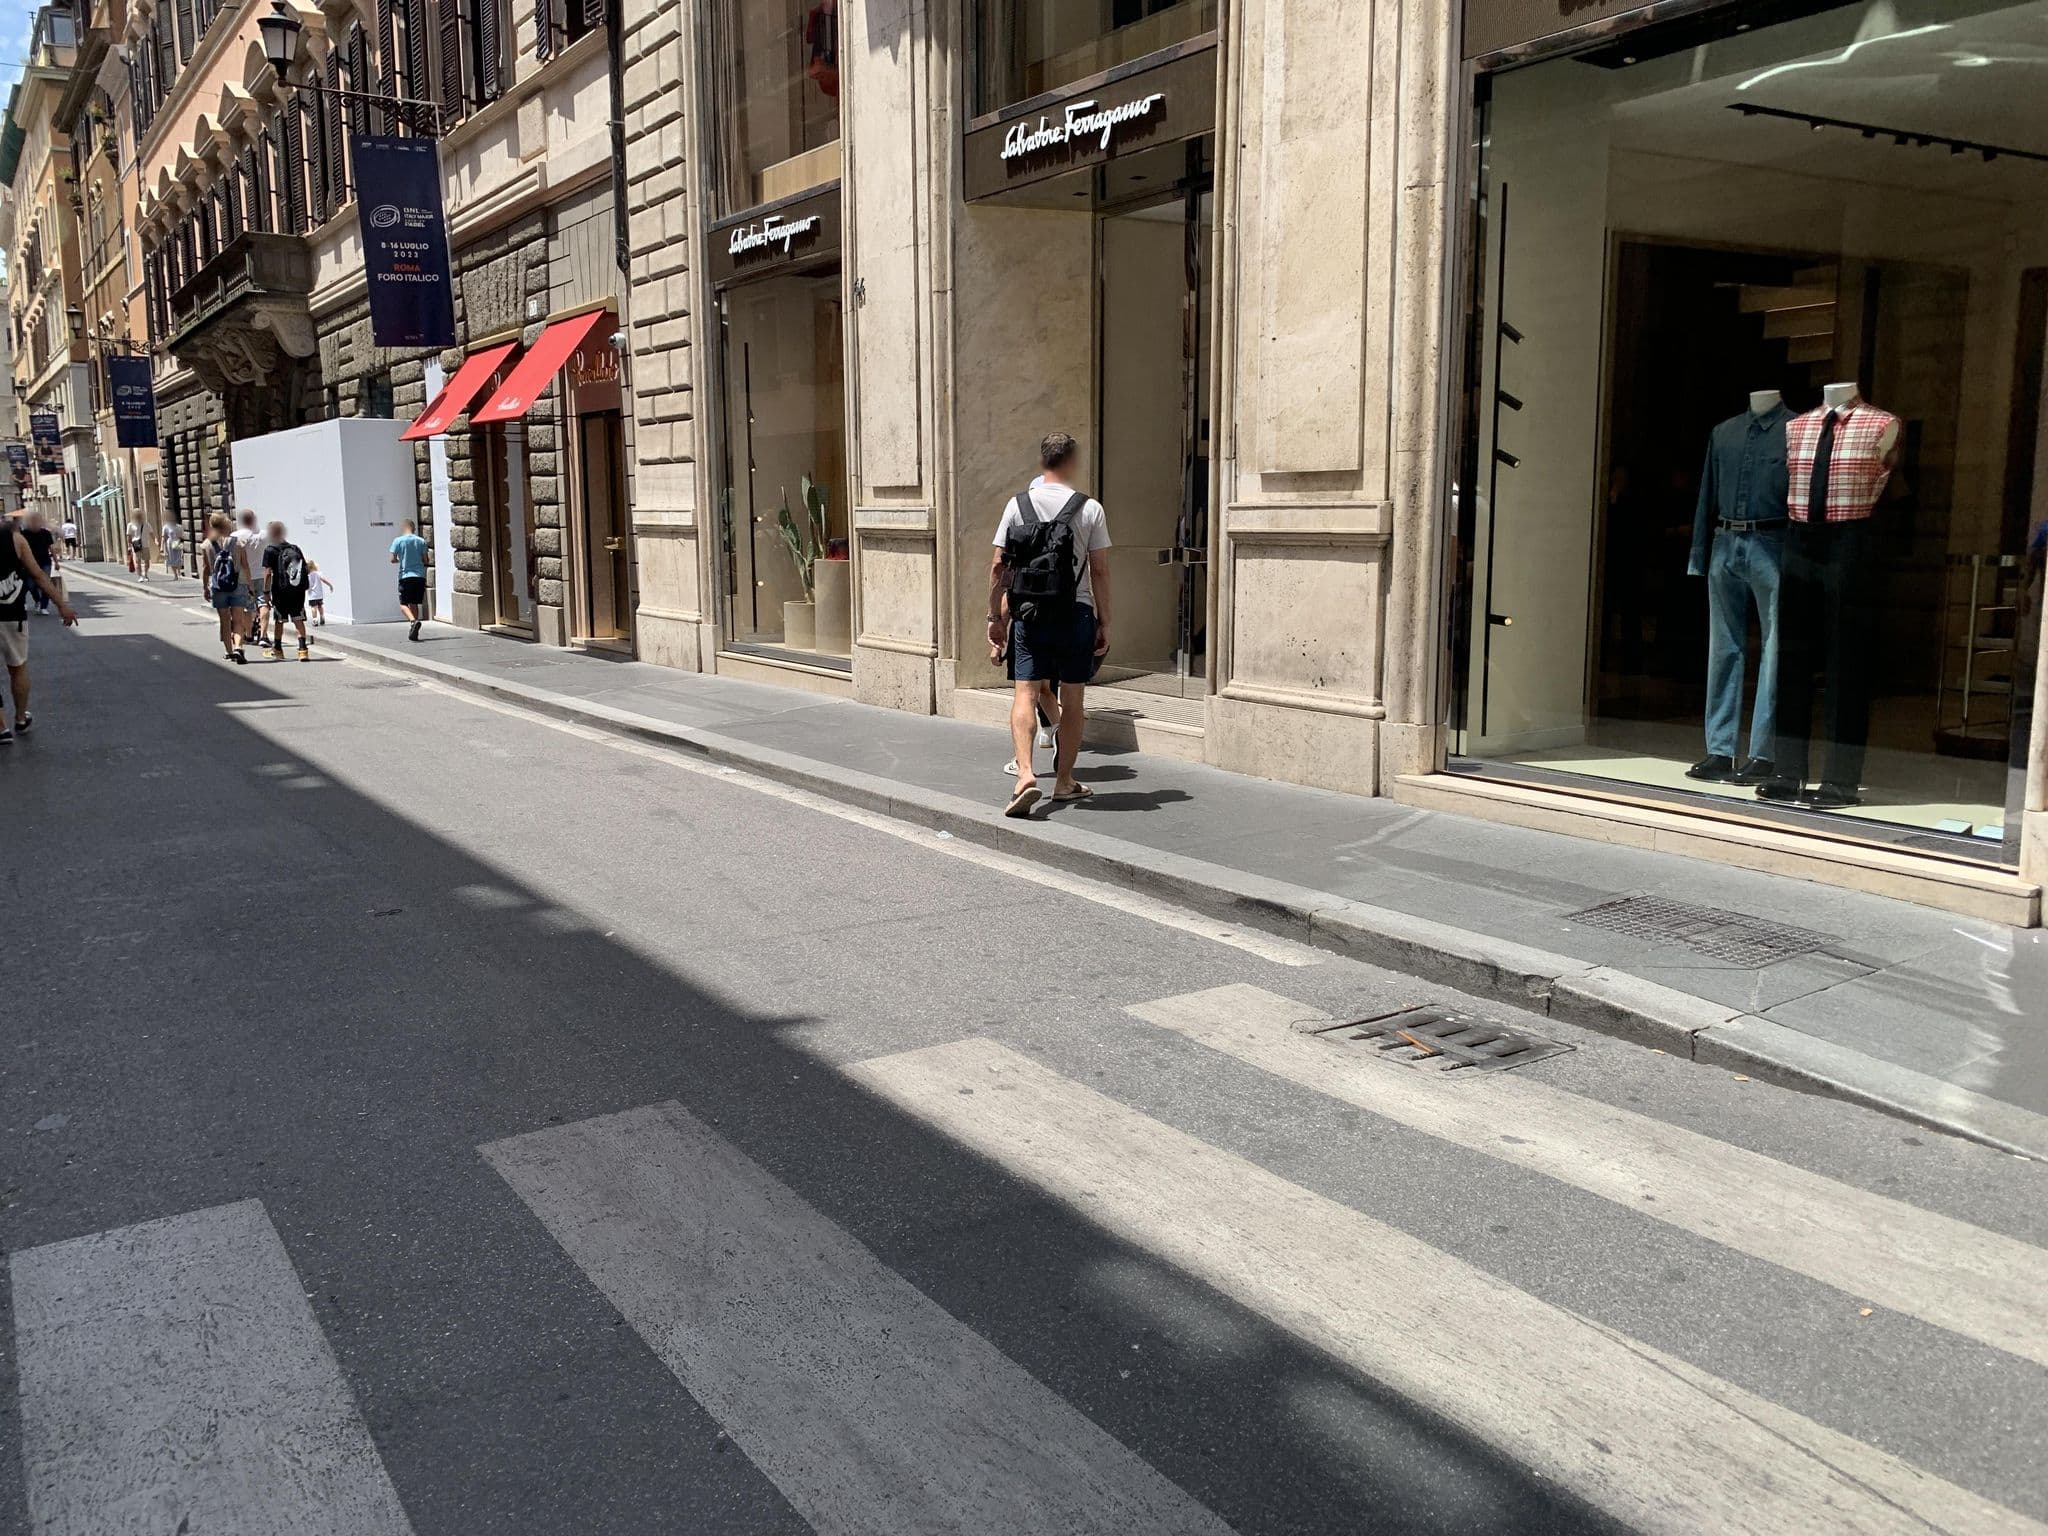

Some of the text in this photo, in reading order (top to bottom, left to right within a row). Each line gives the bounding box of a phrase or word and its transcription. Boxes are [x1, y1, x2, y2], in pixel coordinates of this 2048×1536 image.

[1001, 93, 1166, 160] Salvatore Ferragamo
[728, 215, 821, 255] Salvatore Ferragamo
[399, 242, 429, 250] LUGLIO
[393, 263, 421, 272] ROMA
[377, 273, 440, 282] FORO ITALICO
